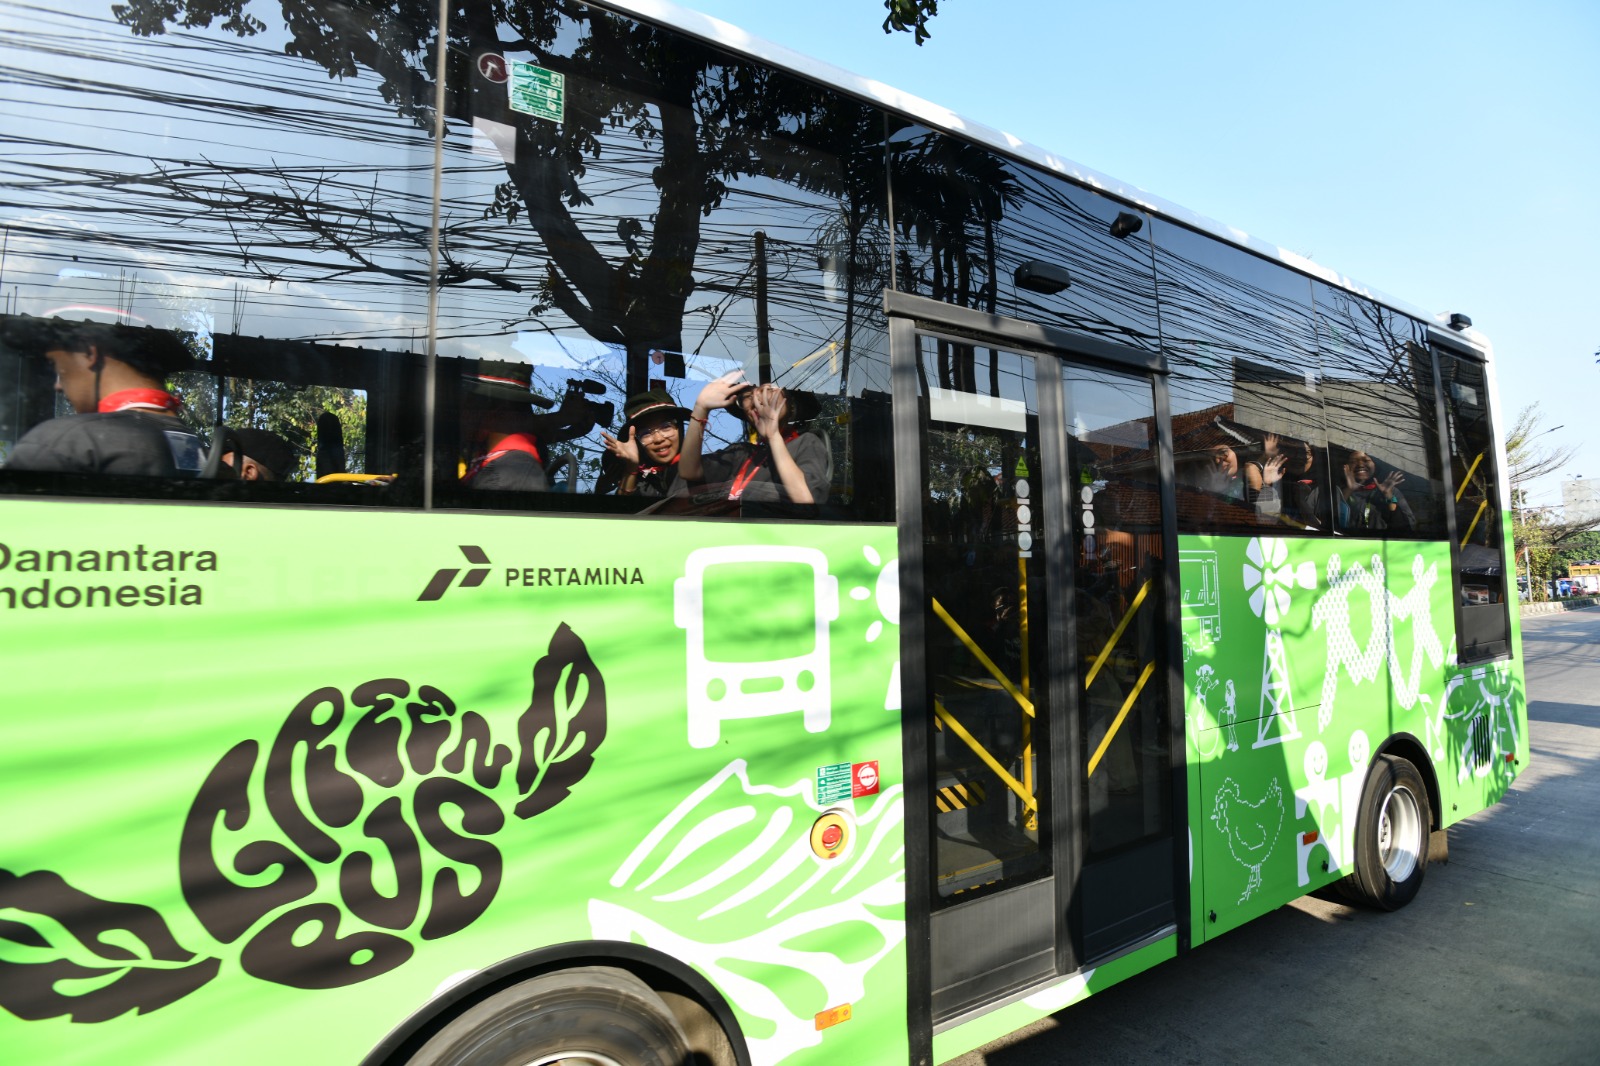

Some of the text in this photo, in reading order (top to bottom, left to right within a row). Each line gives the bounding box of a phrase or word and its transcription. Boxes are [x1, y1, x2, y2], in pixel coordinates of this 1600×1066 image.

[0, 577, 202, 609] ndonesia
[506, 567, 644, 587] PERTAMINA
[179, 678, 513, 944] GREEN
[240, 777, 505, 989] BUS
